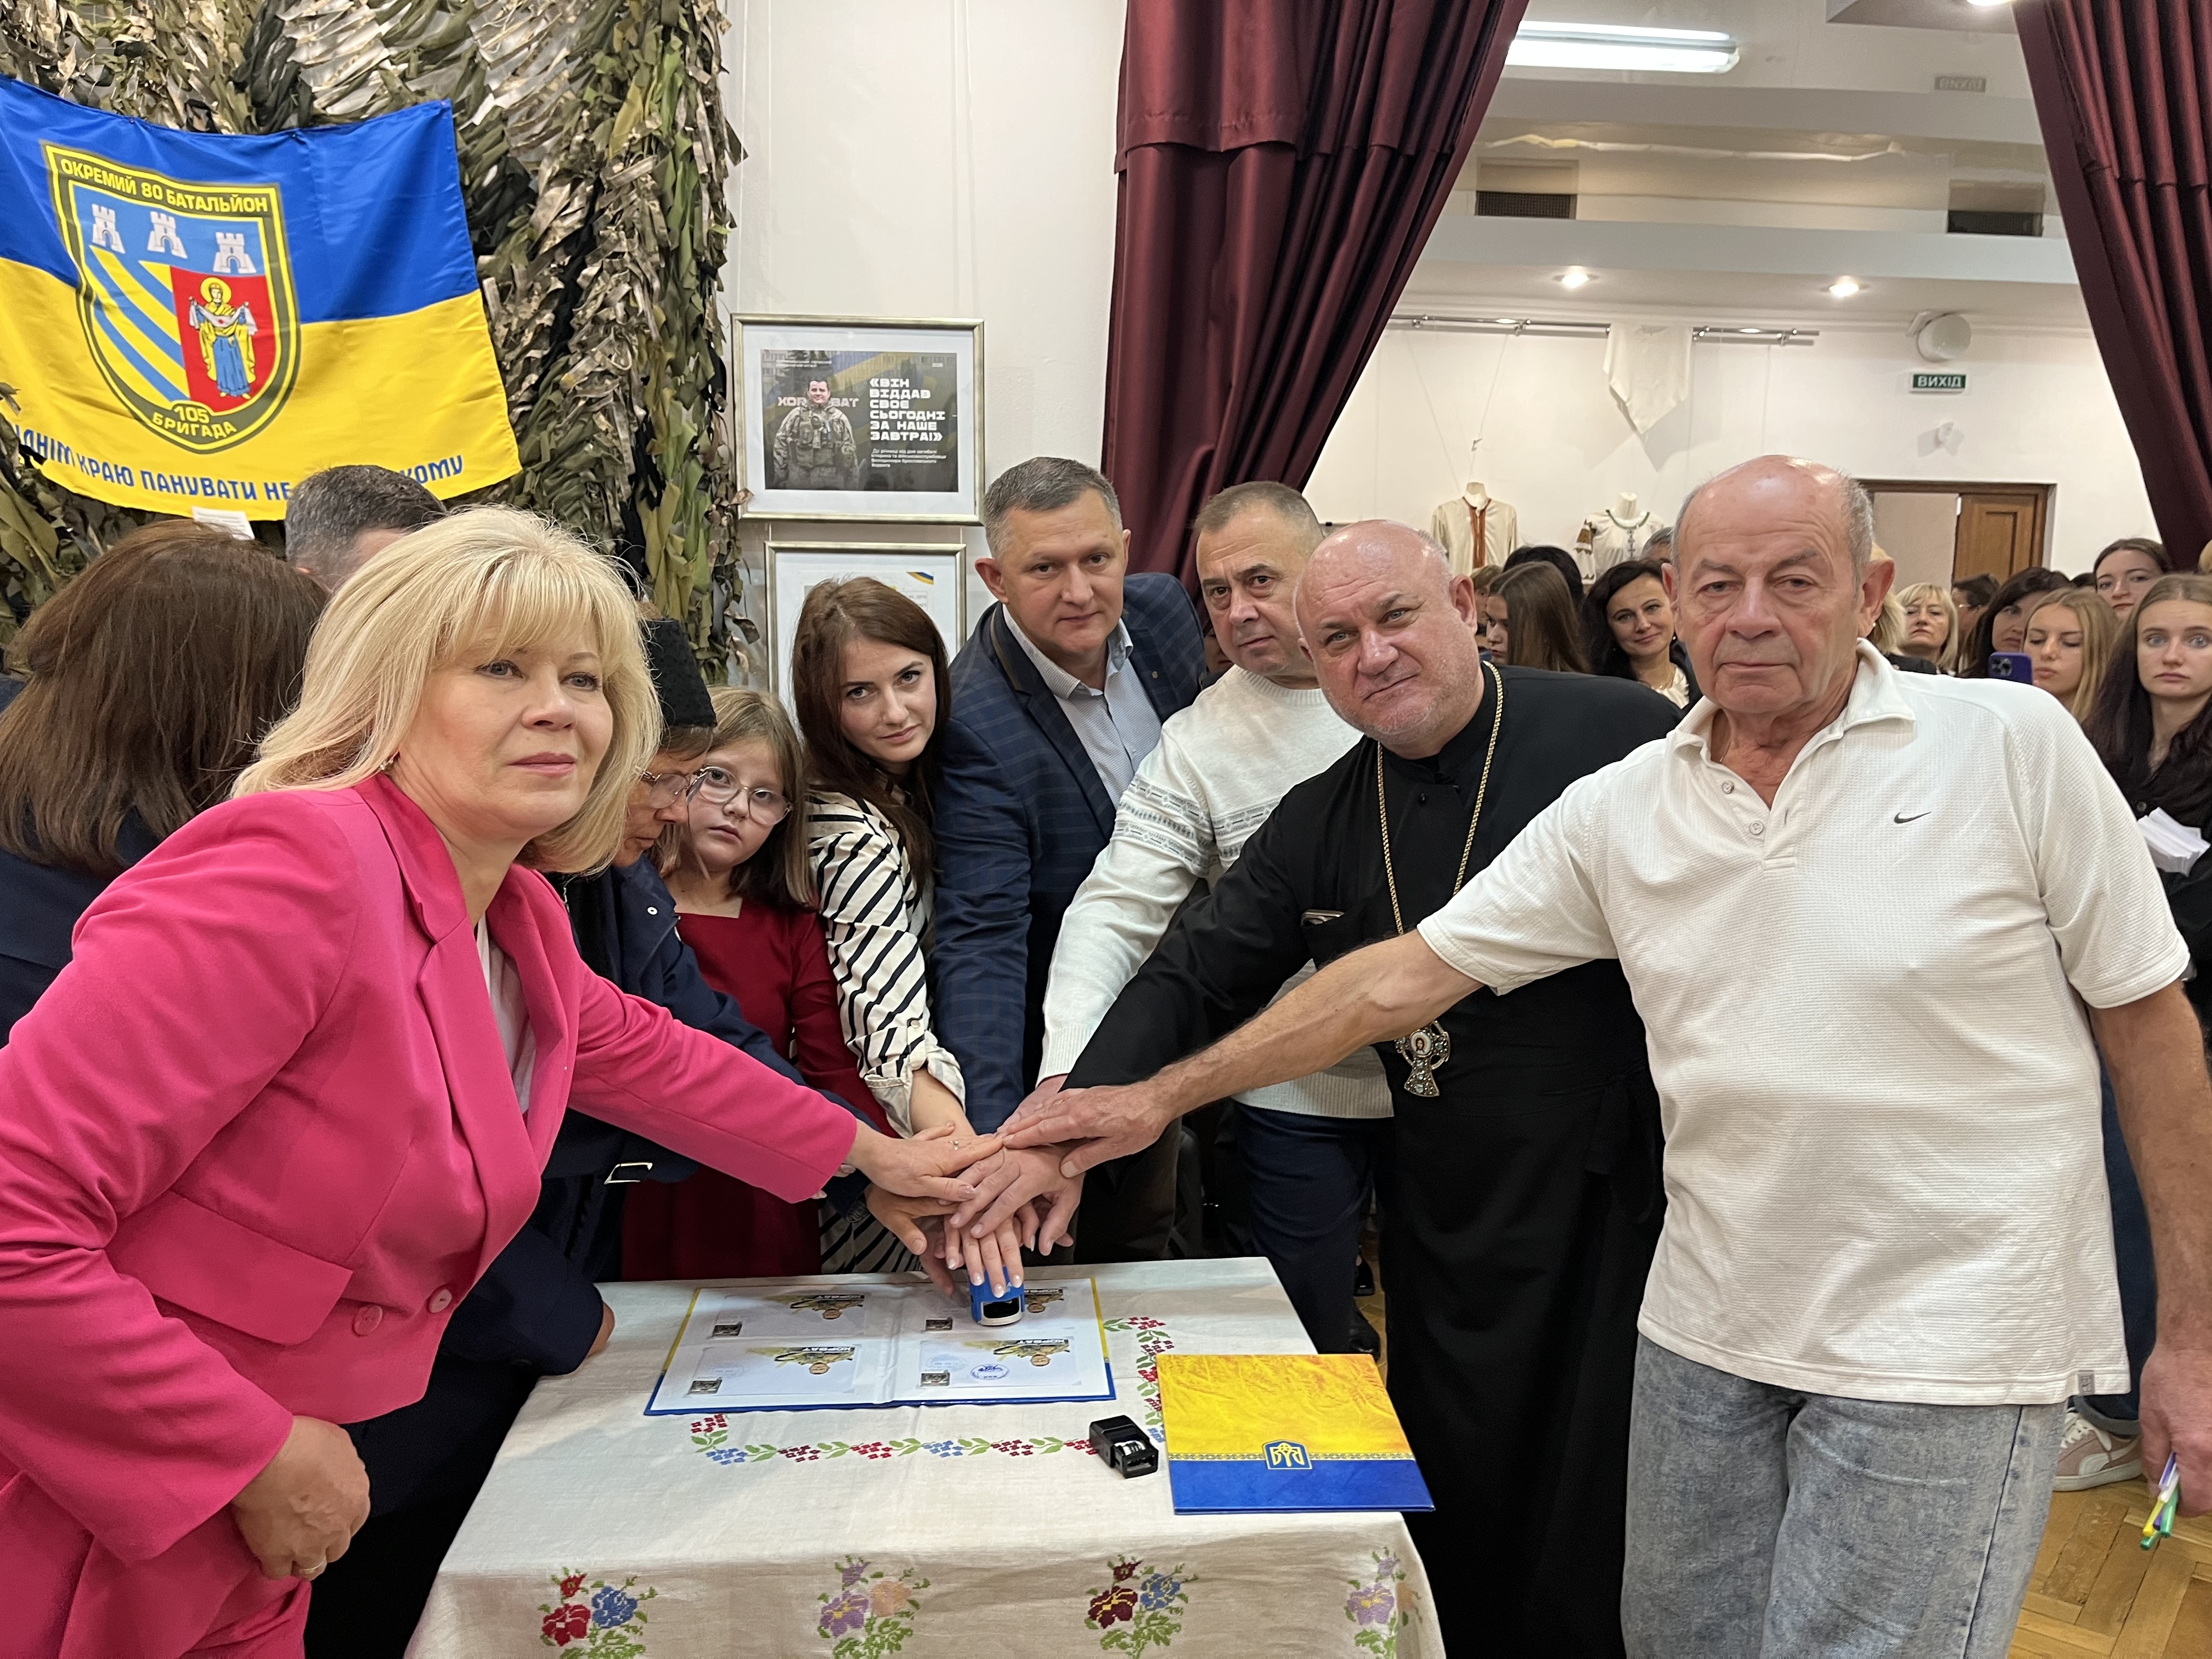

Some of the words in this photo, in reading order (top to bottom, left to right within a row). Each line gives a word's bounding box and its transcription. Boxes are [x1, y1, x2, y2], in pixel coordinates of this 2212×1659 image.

[60, 158, 137, 195] ОКРЕМИЙ
[141, 182, 163, 200] 80
[166, 189, 268, 212] БАТАЛЬЙОН
[870, 378, 910, 388] «ВІН
[1917, 376, 1961, 387] ВИХІД
[870, 388, 931, 399] ВІДДАВ
[174, 406, 210, 424] 105
[870, 410, 946, 421] СЬОГОДНІ
[153, 411, 238, 439] БРИГАДА
[870, 421, 890, 430] ЗА
[897, 421, 937, 431] НАШЕ
[870, 431, 943, 441] ЗАВТРА!»
[76, 453, 134, 487] КРАЮ
[140, 470, 258, 500] ПАНУВАТИ
[264, 482, 290, 500] НЕ
